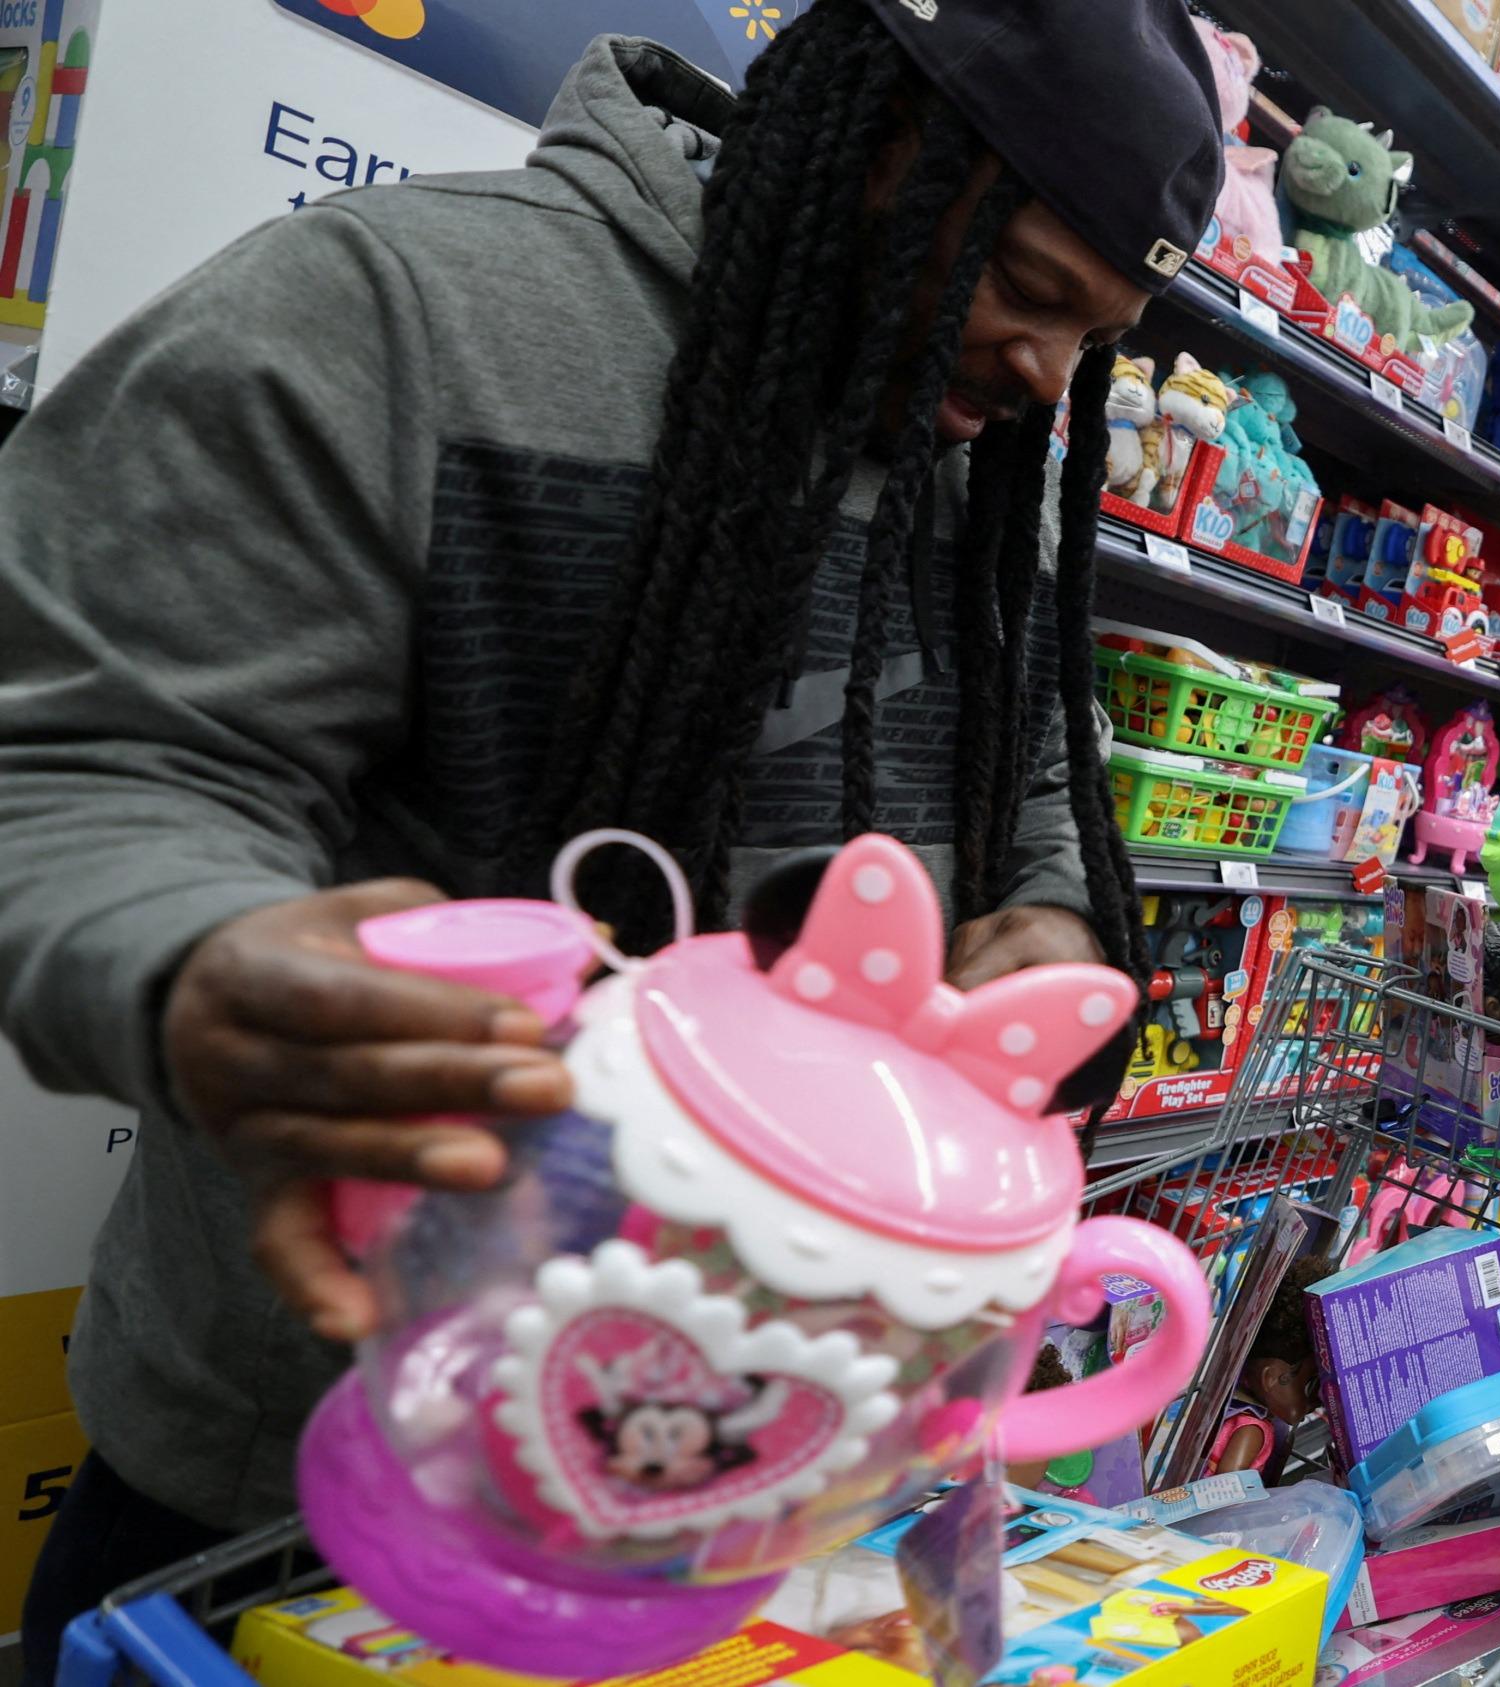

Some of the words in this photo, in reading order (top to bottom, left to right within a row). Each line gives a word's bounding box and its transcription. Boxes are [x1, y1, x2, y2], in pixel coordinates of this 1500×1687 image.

[264, 100, 409, 187] Ear
[1339, 303, 1371, 343] KID
[1196, 508, 1232, 539] KID
[1366, 602, 1387, 618] KID
[1407, 610, 1430, 627] KID
[1156, 1079, 1213, 1097] Firefighter
[1160, 1094, 1185, 1109] Play
[1186, 1091, 1204, 1105] Set
